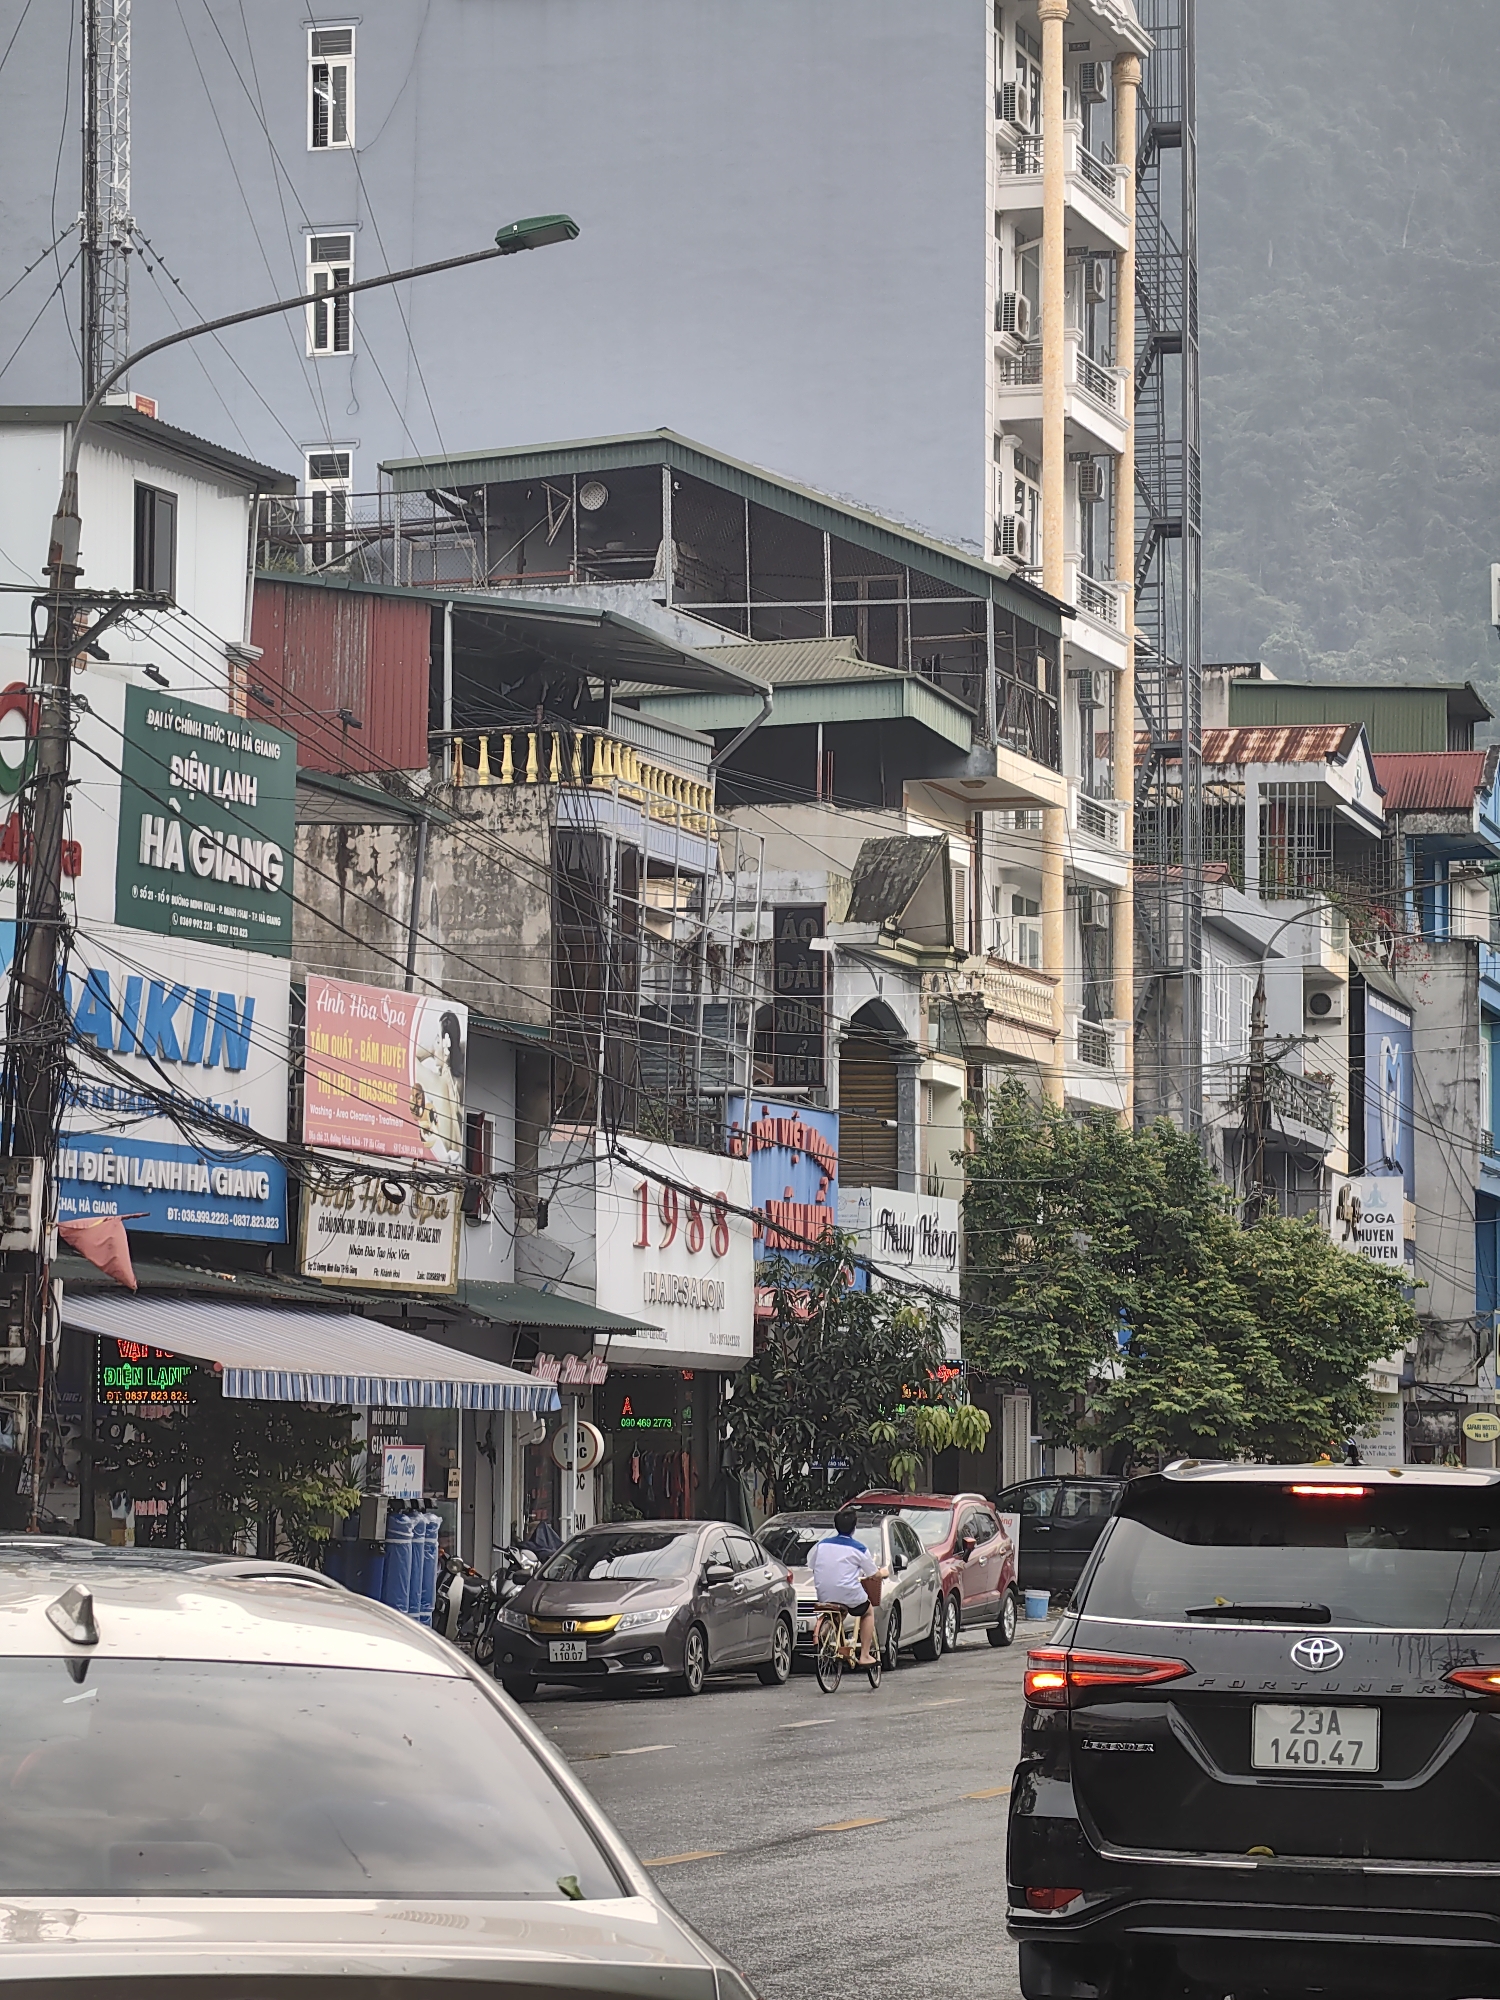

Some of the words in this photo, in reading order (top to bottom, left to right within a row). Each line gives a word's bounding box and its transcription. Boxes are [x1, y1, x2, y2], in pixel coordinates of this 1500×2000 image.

[146, 709, 163, 731] ĐẠI
[164, 708, 173, 729] LÝ
[175, 713, 201, 738] CHÍNH
[203, 721, 225, 743] THỨC
[227, 731, 239, 752] TẠI
[241, 731, 253, 752] HÀ
[254, 739, 280, 759] GIANG
[169, 751, 210, 800] ĐIỆN
[213, 766, 258, 809] LẠNH
[139, 798, 185, 872] HÀ
[189, 825, 284, 892] GIANG
[349, 993, 378, 1021] Hòa
[380, 994, 407, 1029] Spa
[381, 1042, 407, 1073] HUYỆT
[359, 1077, 398, 1105] MASSAGE
[309, 1104, 332, 1119] Washing
[336, 1108, 349, 1119] Area
[79, 1147, 129, 1190] ĐIỆN
[130, 1157, 182, 1193] LẠNH
[182, 1158, 211, 1194] HÀ
[211, 1166, 270, 1200] GIANG
[78, 1196, 91, 1213] HÀ
[92, 1200, 118, 1215] GIANG
[167, 1208, 181, 1222] ĐT:
[181, 1209, 229, 1226] 036.999.2228
[632, 1180, 730, 1258] 1988
[1360, 1246, 1398, 1259] GUYEN
[103, 1362, 143, 1390] ĐIỆN
[534, 1352, 562, 1382] Salon
[124, 1391, 149, 1401] 0837
[150, 1391, 168, 1401] 823
[620, 1418, 636, 1428] 090
[636, 1418, 652, 1428] 469
[652, 1418, 672, 1428] 2773
[554, 1651, 583, 1661] 110.07
[559, 1642, 576, 1651] 23A
[1197, 1677, 1440, 1696] FORTUNER
[1289, 1708, 1342, 1736] 23A
[1081, 1739, 1155, 1753] LEGENDER
[1269, 1738, 1364, 1768] 140.47
